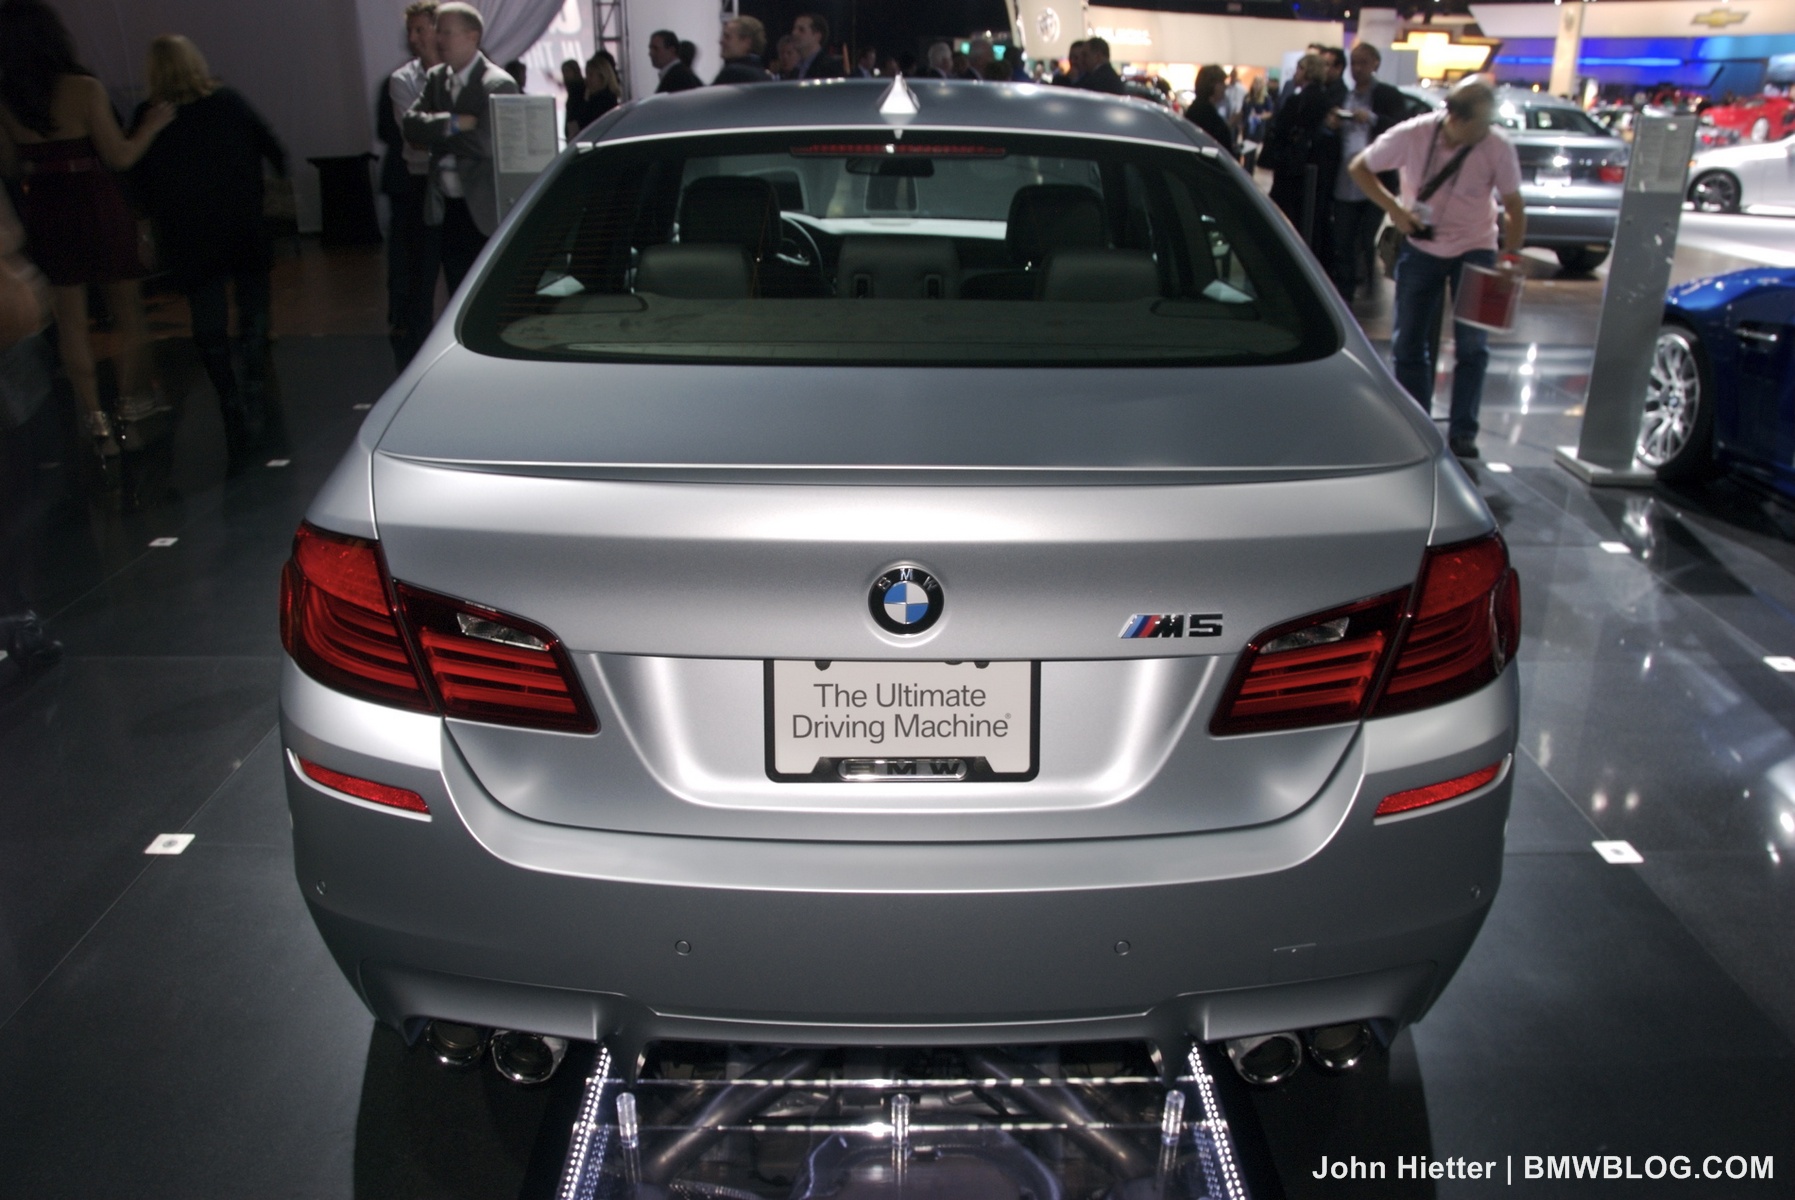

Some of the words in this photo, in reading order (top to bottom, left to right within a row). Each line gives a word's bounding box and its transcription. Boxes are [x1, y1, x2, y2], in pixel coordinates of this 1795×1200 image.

[878, 567, 938, 593] BMW
[1118, 612, 1223, 639] M5
[813, 683, 867, 707] The
[876, 683, 986, 707] Ultimate
[792, 714, 885, 744] Driving
[845, 761, 960, 775] BMW
